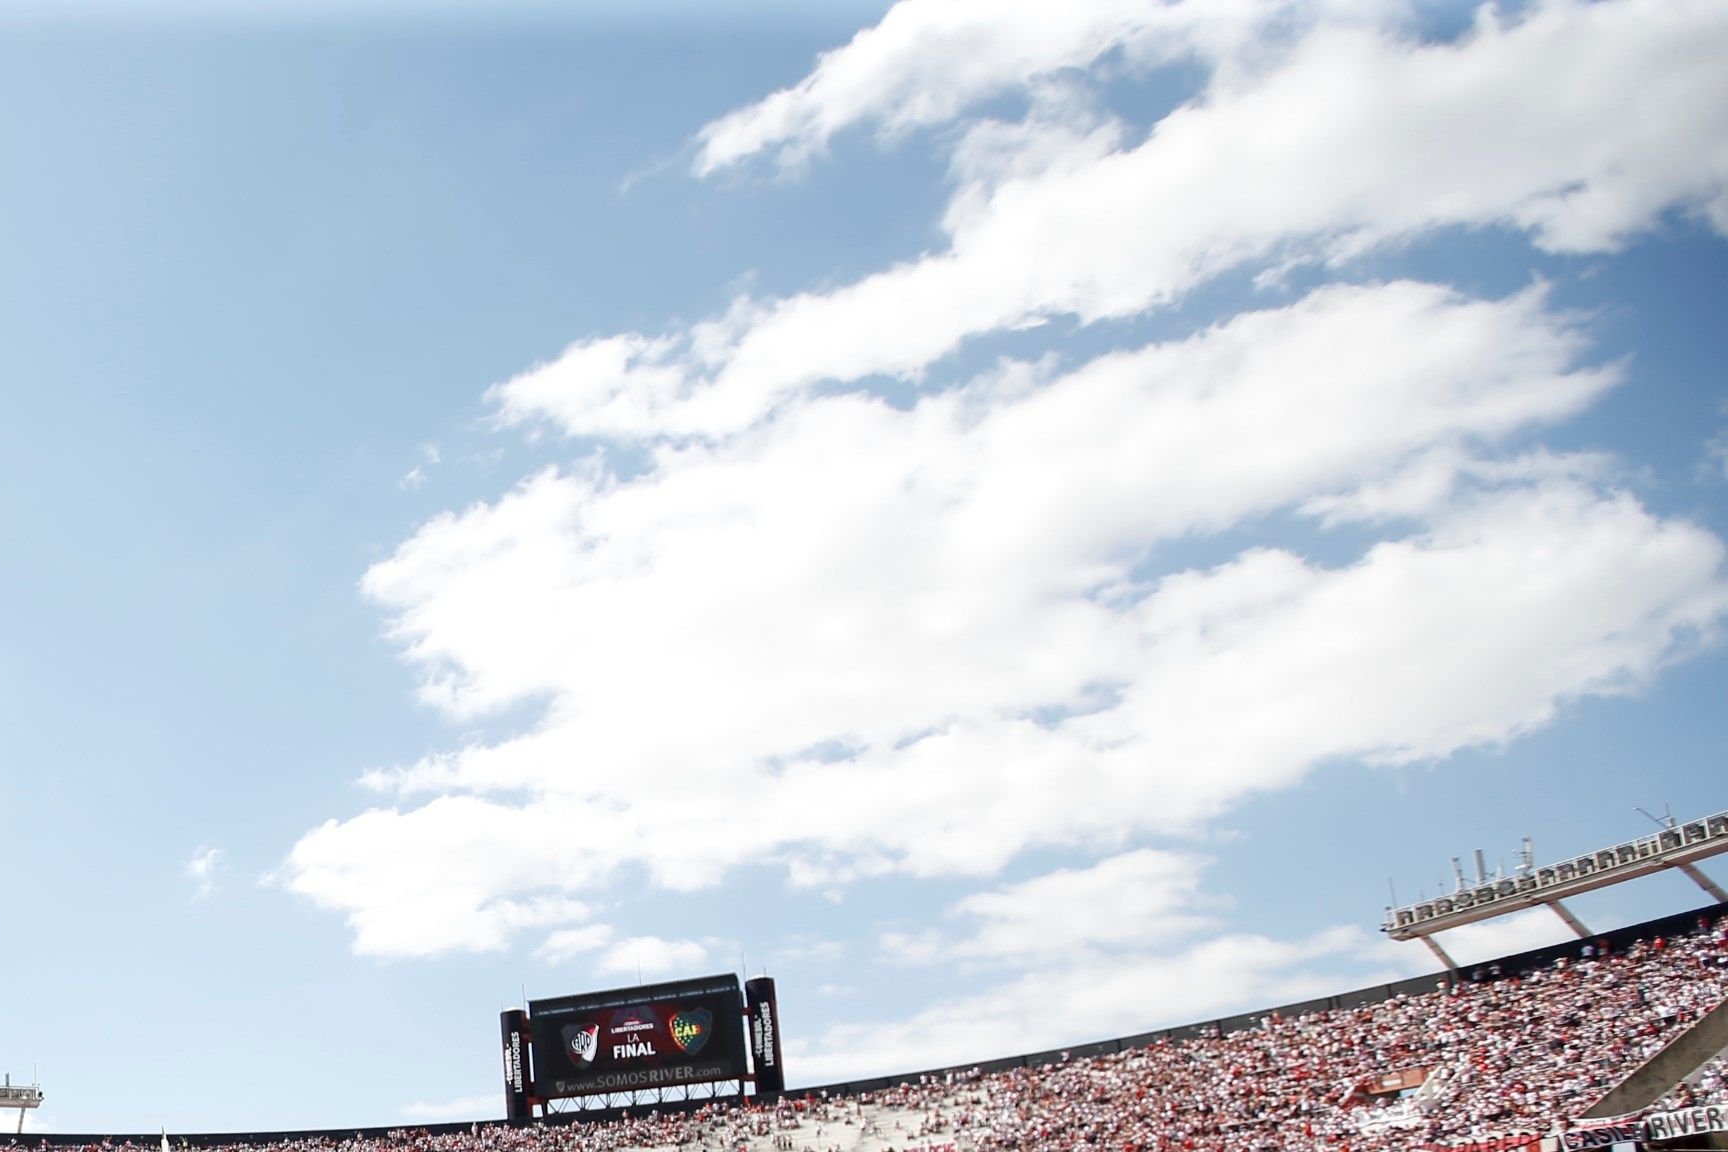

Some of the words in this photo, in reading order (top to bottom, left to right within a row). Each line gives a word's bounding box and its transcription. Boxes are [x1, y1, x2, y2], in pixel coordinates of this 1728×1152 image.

[627, 1033, 639, 1043] LA
[613, 1041, 656, 1059] FINAL
[567, 1066, 721, 1092] www.SOMOSRIVER.com
[1651, 1107, 1723, 1138] RIVER
